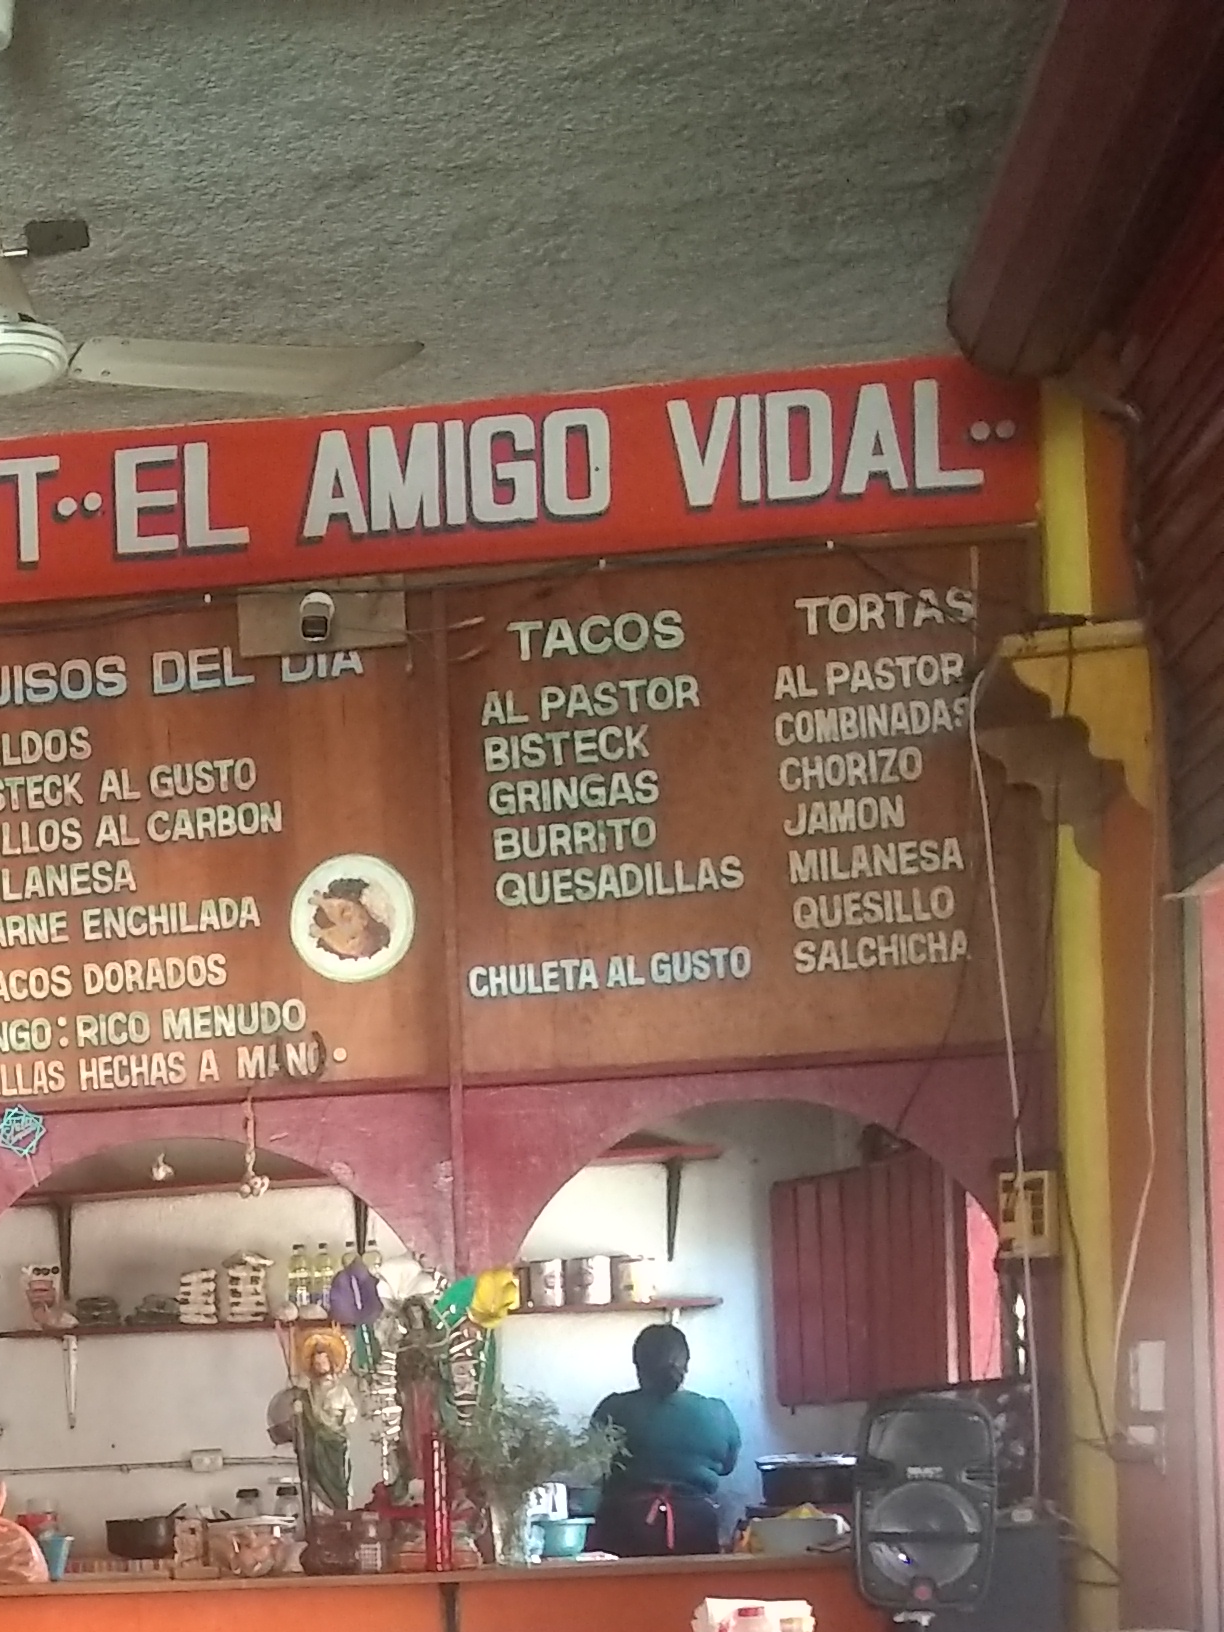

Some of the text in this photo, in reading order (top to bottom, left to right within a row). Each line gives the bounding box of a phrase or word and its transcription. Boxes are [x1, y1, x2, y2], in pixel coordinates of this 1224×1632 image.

[115, 441, 251, 553] EL
[303, 408, 611, 538] AMIGO
[666, 379, 984, 507] VIDAL
[794, 586, 975, 636] TORTAS
[507, 609, 686, 662] TACOS
[152, 647, 255, 696] DEL
[281, 650, 364, 682] DIA
[775, 652, 964, 700] AL PASTOR
[481, 675, 700, 726] AL PASTOR
[774, 696, 969, 747] COMBINADAS
[483, 725, 650, 773] BISTECK
[779, 746, 923, 792] CHORIZO
[99, 769, 141, 803] AL
[149, 757, 257, 799] GUSTO
[487, 770, 660, 816] GRINGAS
[95, 814, 140, 849] AL
[147, 801, 282, 843] CARBON
[493, 815, 657, 862] BURRITO
[783, 795, 906, 838] JAMON
[495, 855, 746, 907] QUESADILLAS
[788, 838, 966, 885] MILANESA
[82, 897, 261, 942] ENCHILADA
[793, 885, 955, 930] QUESILLO
[84, 954, 228, 996] DORADOS
[468, 946, 752, 1000] CHULETA AL GUSTO
[794, 930, 969, 974] SALCHICHA
[77, 1012, 150, 1049] RICO
[163, 998, 307, 1042] MENUDO
[80, 1051, 187, 1092] HECHAS
[199, 1048, 221, 1082] A
